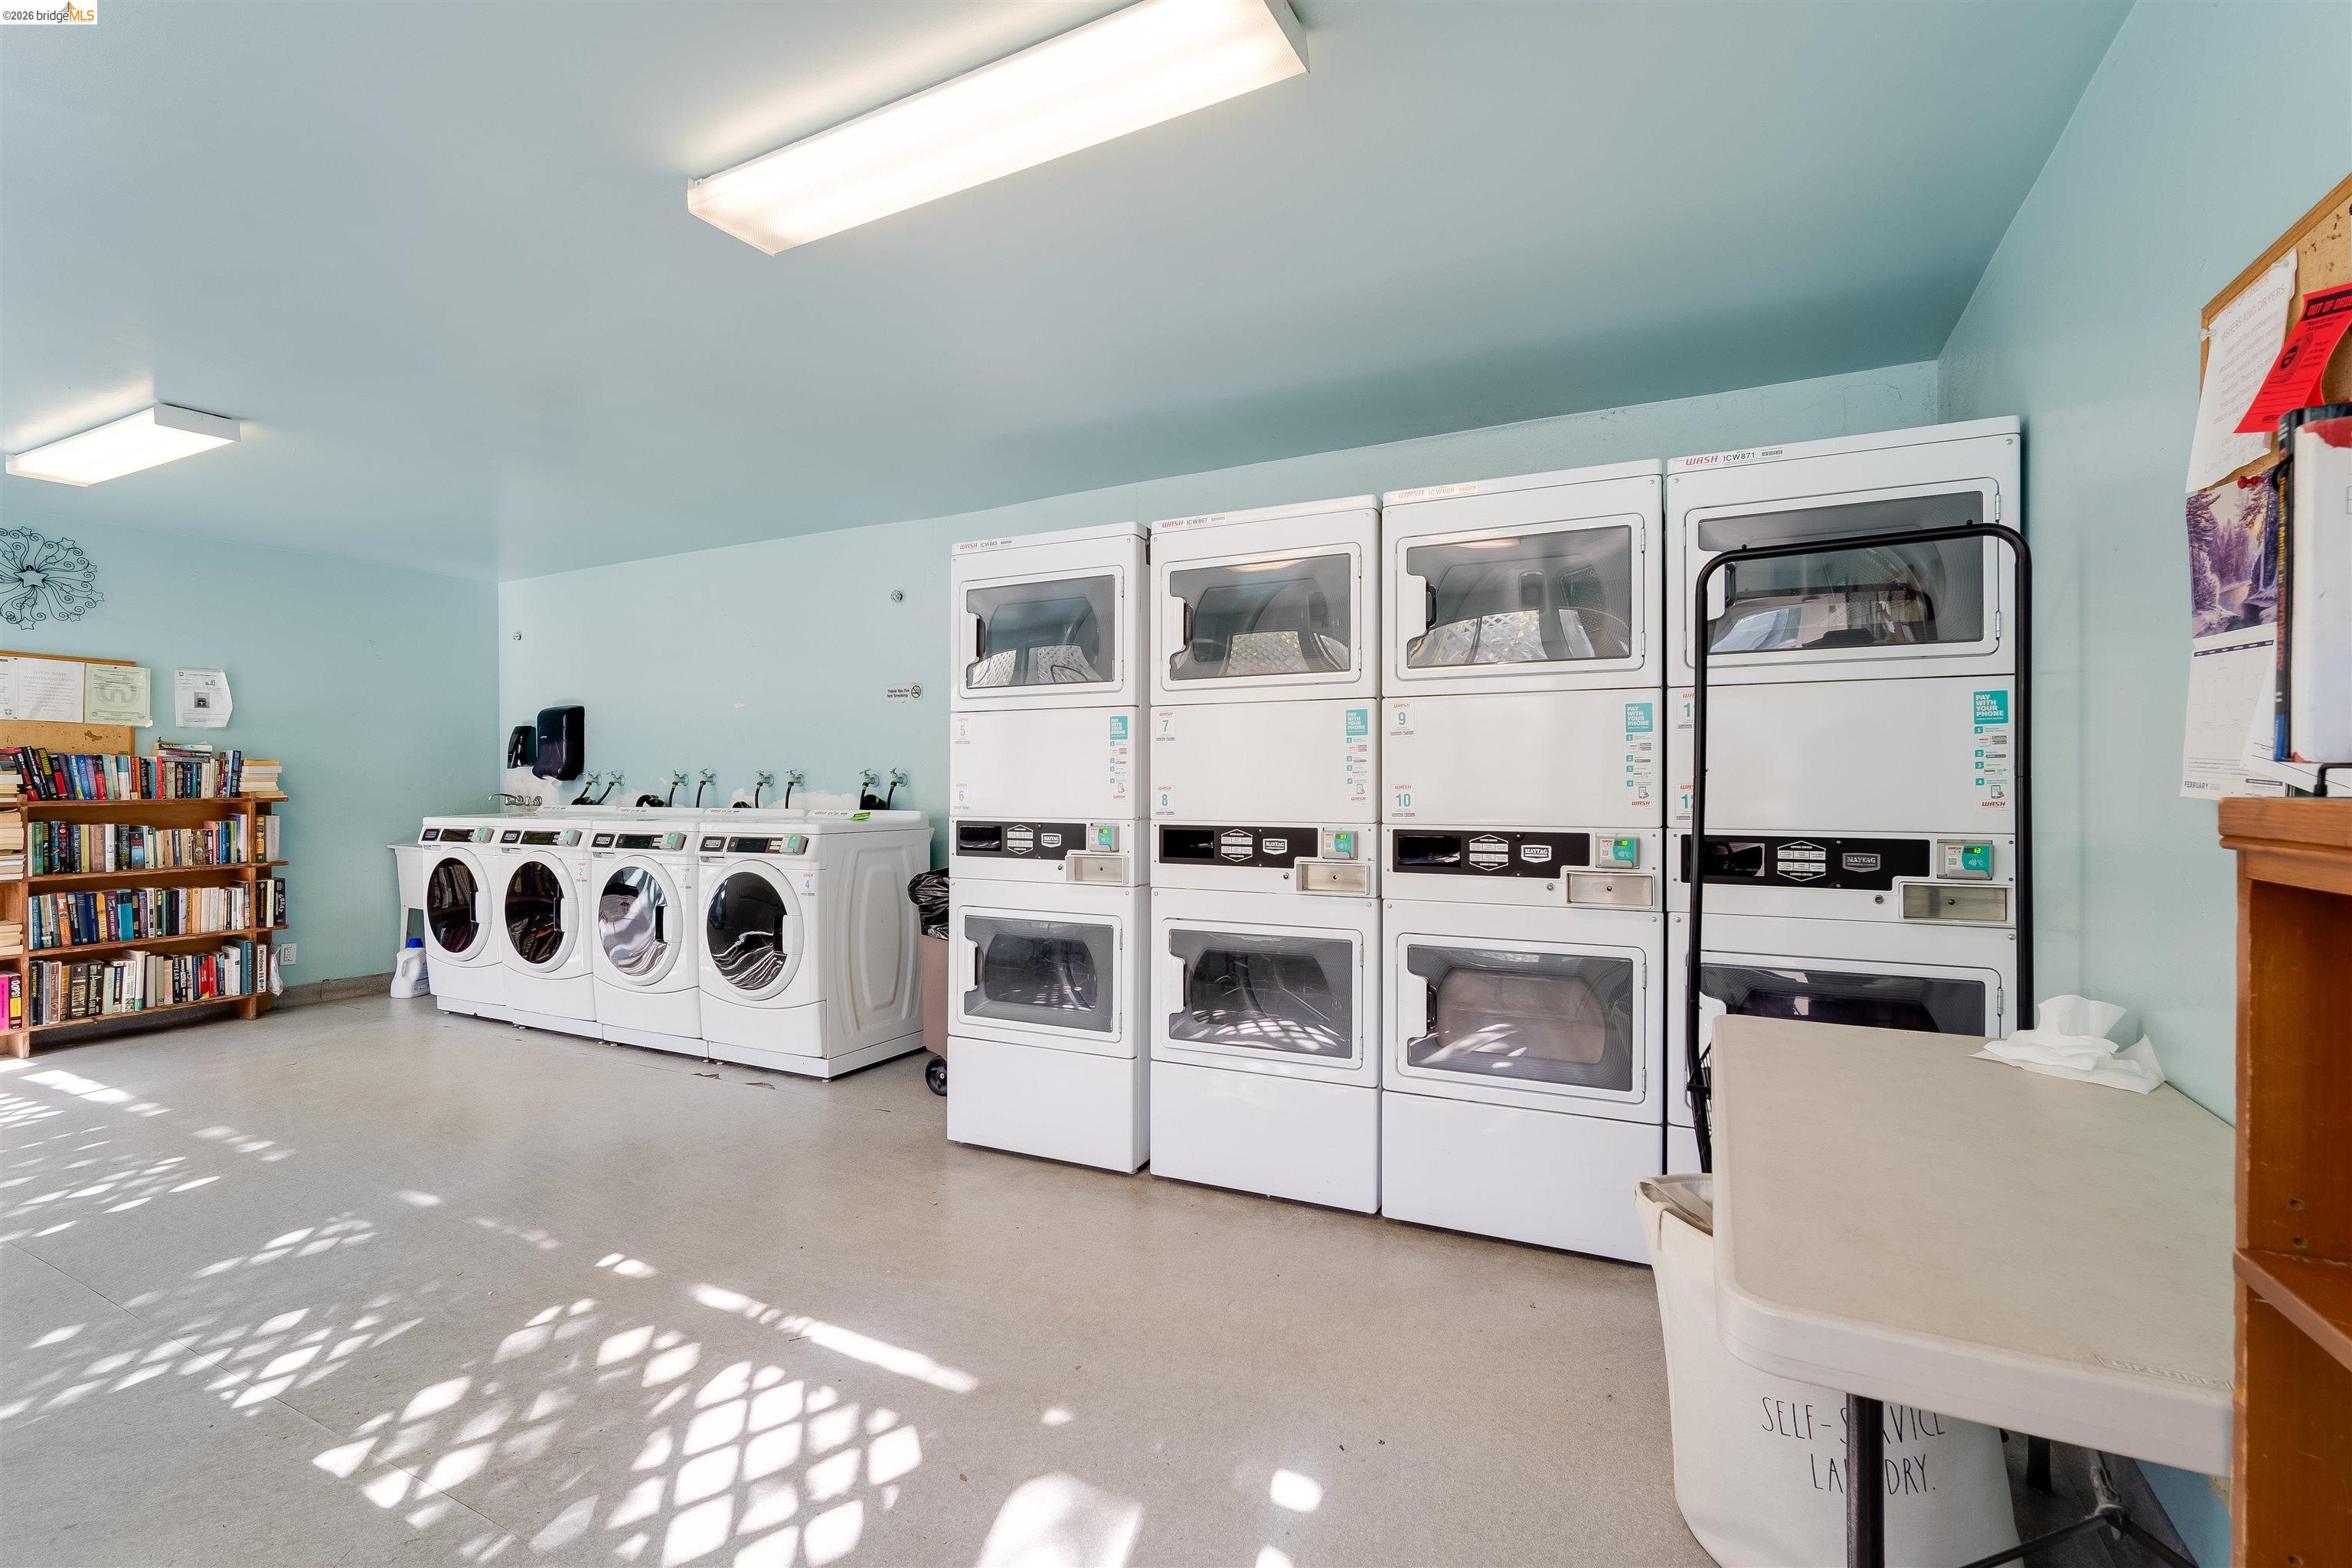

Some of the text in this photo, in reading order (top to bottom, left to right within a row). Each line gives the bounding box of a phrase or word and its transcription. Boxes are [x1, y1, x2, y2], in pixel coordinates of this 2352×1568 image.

[2258, 283, 2285, 311] DRYERS
[2307, 302, 2324, 316] OUT
[2322, 299, 2335, 313] OF
[1685, 452, 1755, 466] WASH ICW871
[2278, 476, 2286, 524] Research
[1162, 520, 1184, 528] WASH
[2278, 526, 2286, 570] Methods
[1683, 703, 1695, 717] 1
[1398, 711, 1406, 726] 9
[960, 725, 965, 736] 5
[1162, 720, 1168, 732] 7
[2184, 781, 2209, 789] FEBRUARY
[959, 790, 964, 802] 6
[1161, 794, 1168, 806] 8
[1396, 793, 1411, 807] 10
[805, 880, 810, 890] 4
[11, 980, 21, 998] OOPS!
[1810, 1453, 1936, 1495] LADRY.
